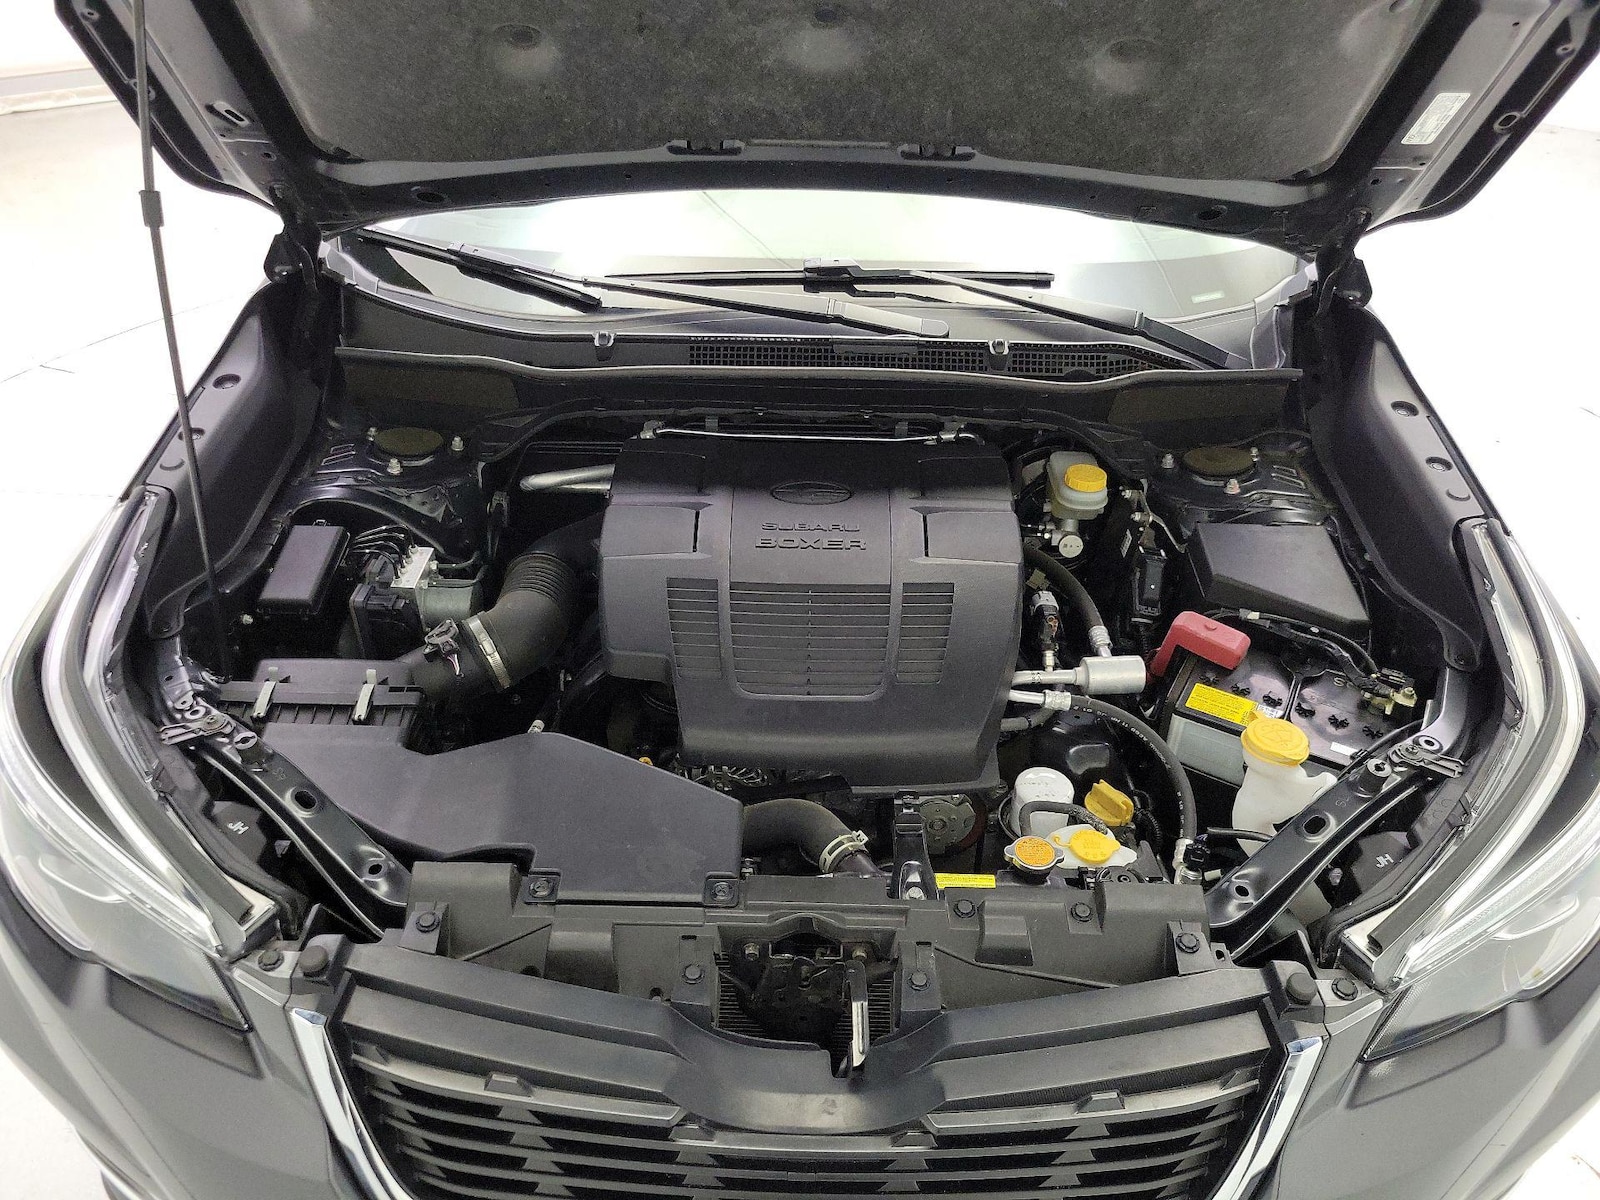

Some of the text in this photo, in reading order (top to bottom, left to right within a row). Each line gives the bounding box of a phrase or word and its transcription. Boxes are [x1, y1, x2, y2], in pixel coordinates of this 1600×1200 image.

[761, 522, 861, 532] SUBARU
[755, 538, 867, 550] BOXER
[227, 821, 249, 834] JH
[1376, 853, 1394, 868] JH
